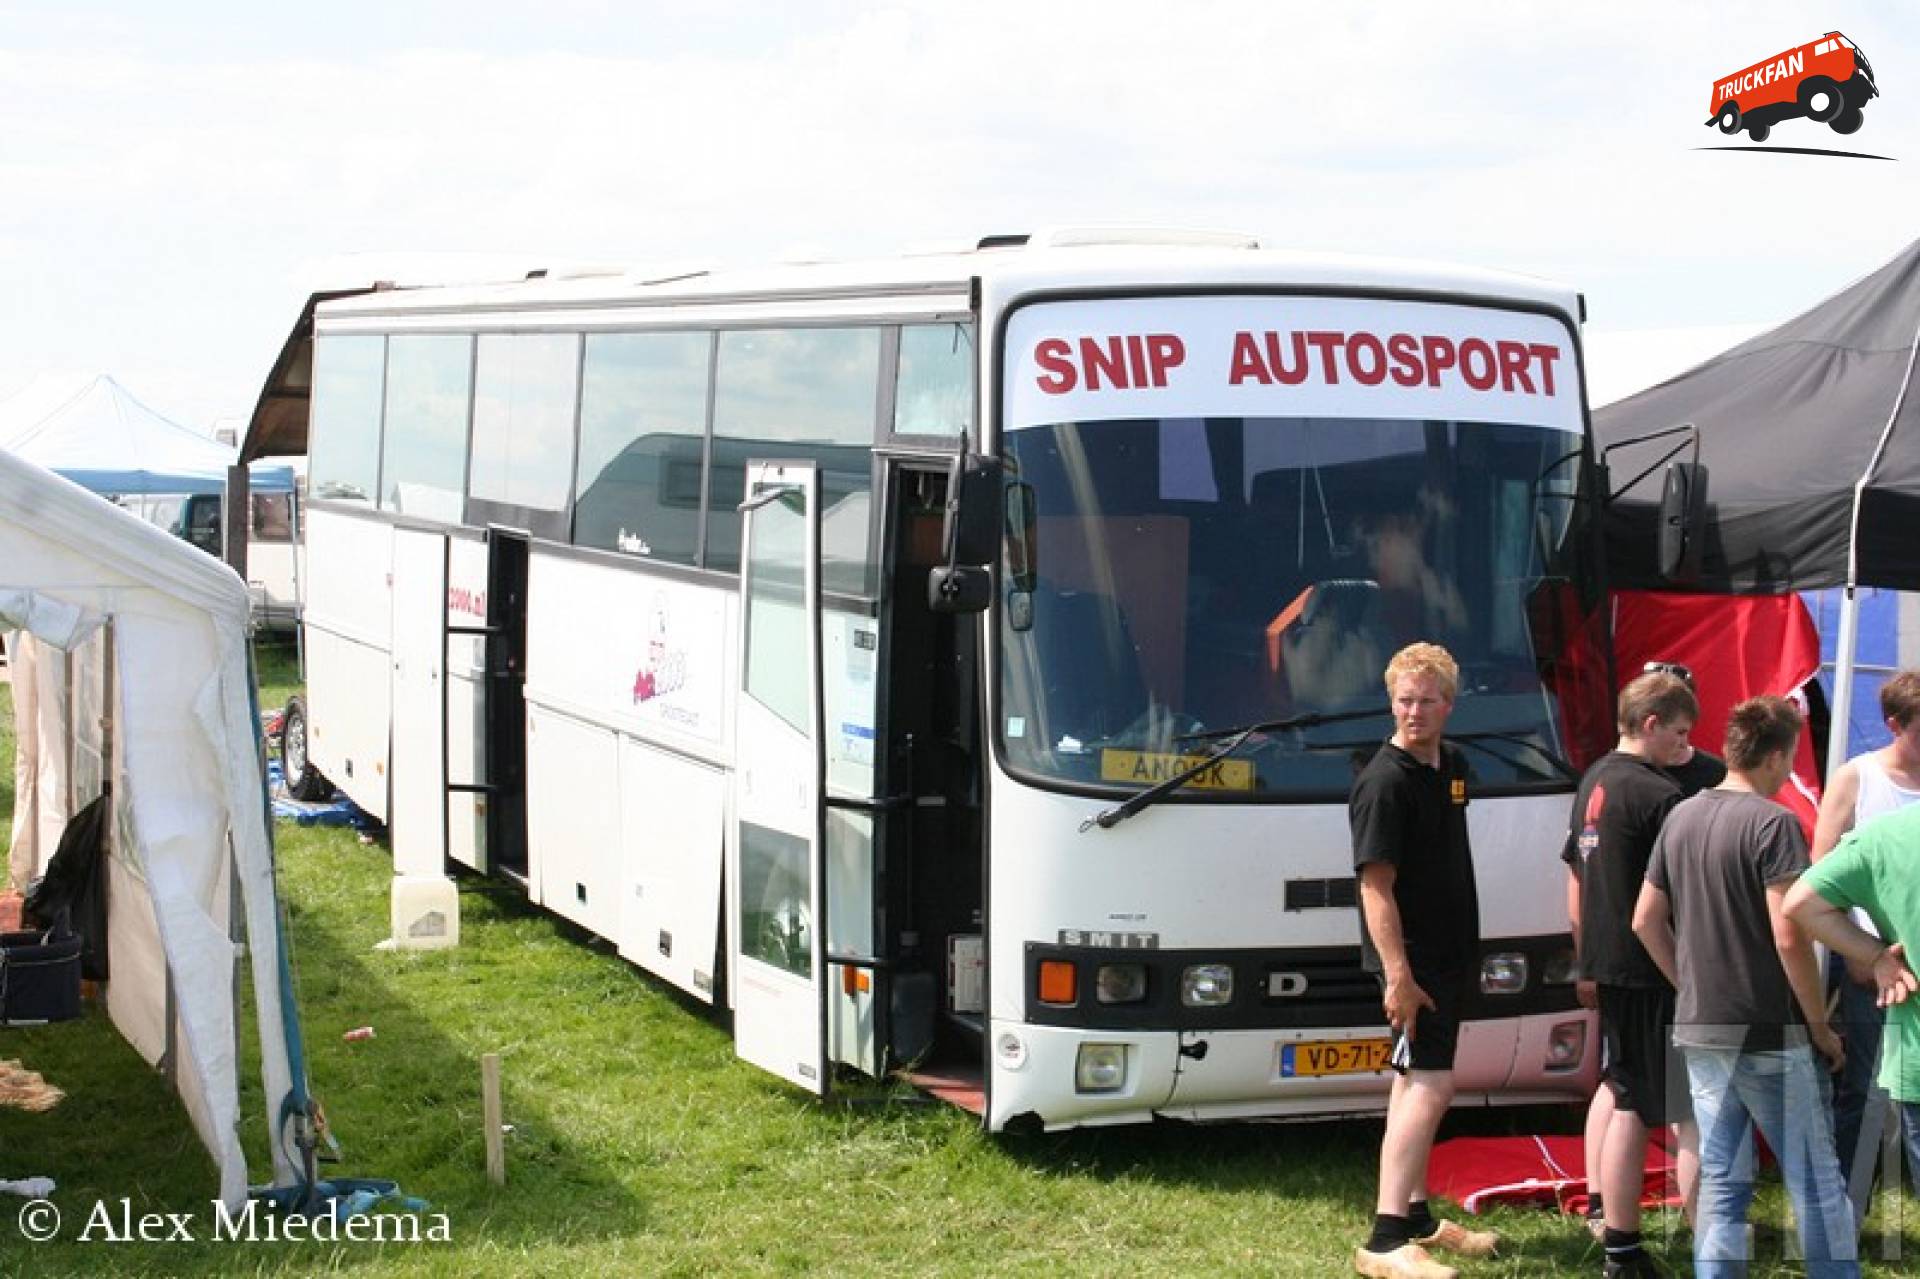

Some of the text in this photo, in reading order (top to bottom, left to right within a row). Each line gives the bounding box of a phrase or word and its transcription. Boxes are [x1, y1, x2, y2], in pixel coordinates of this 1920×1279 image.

[1034, 330, 1560, 397] SNIP AUTOSPORT
[1063, 930, 1155, 949] SMIT
